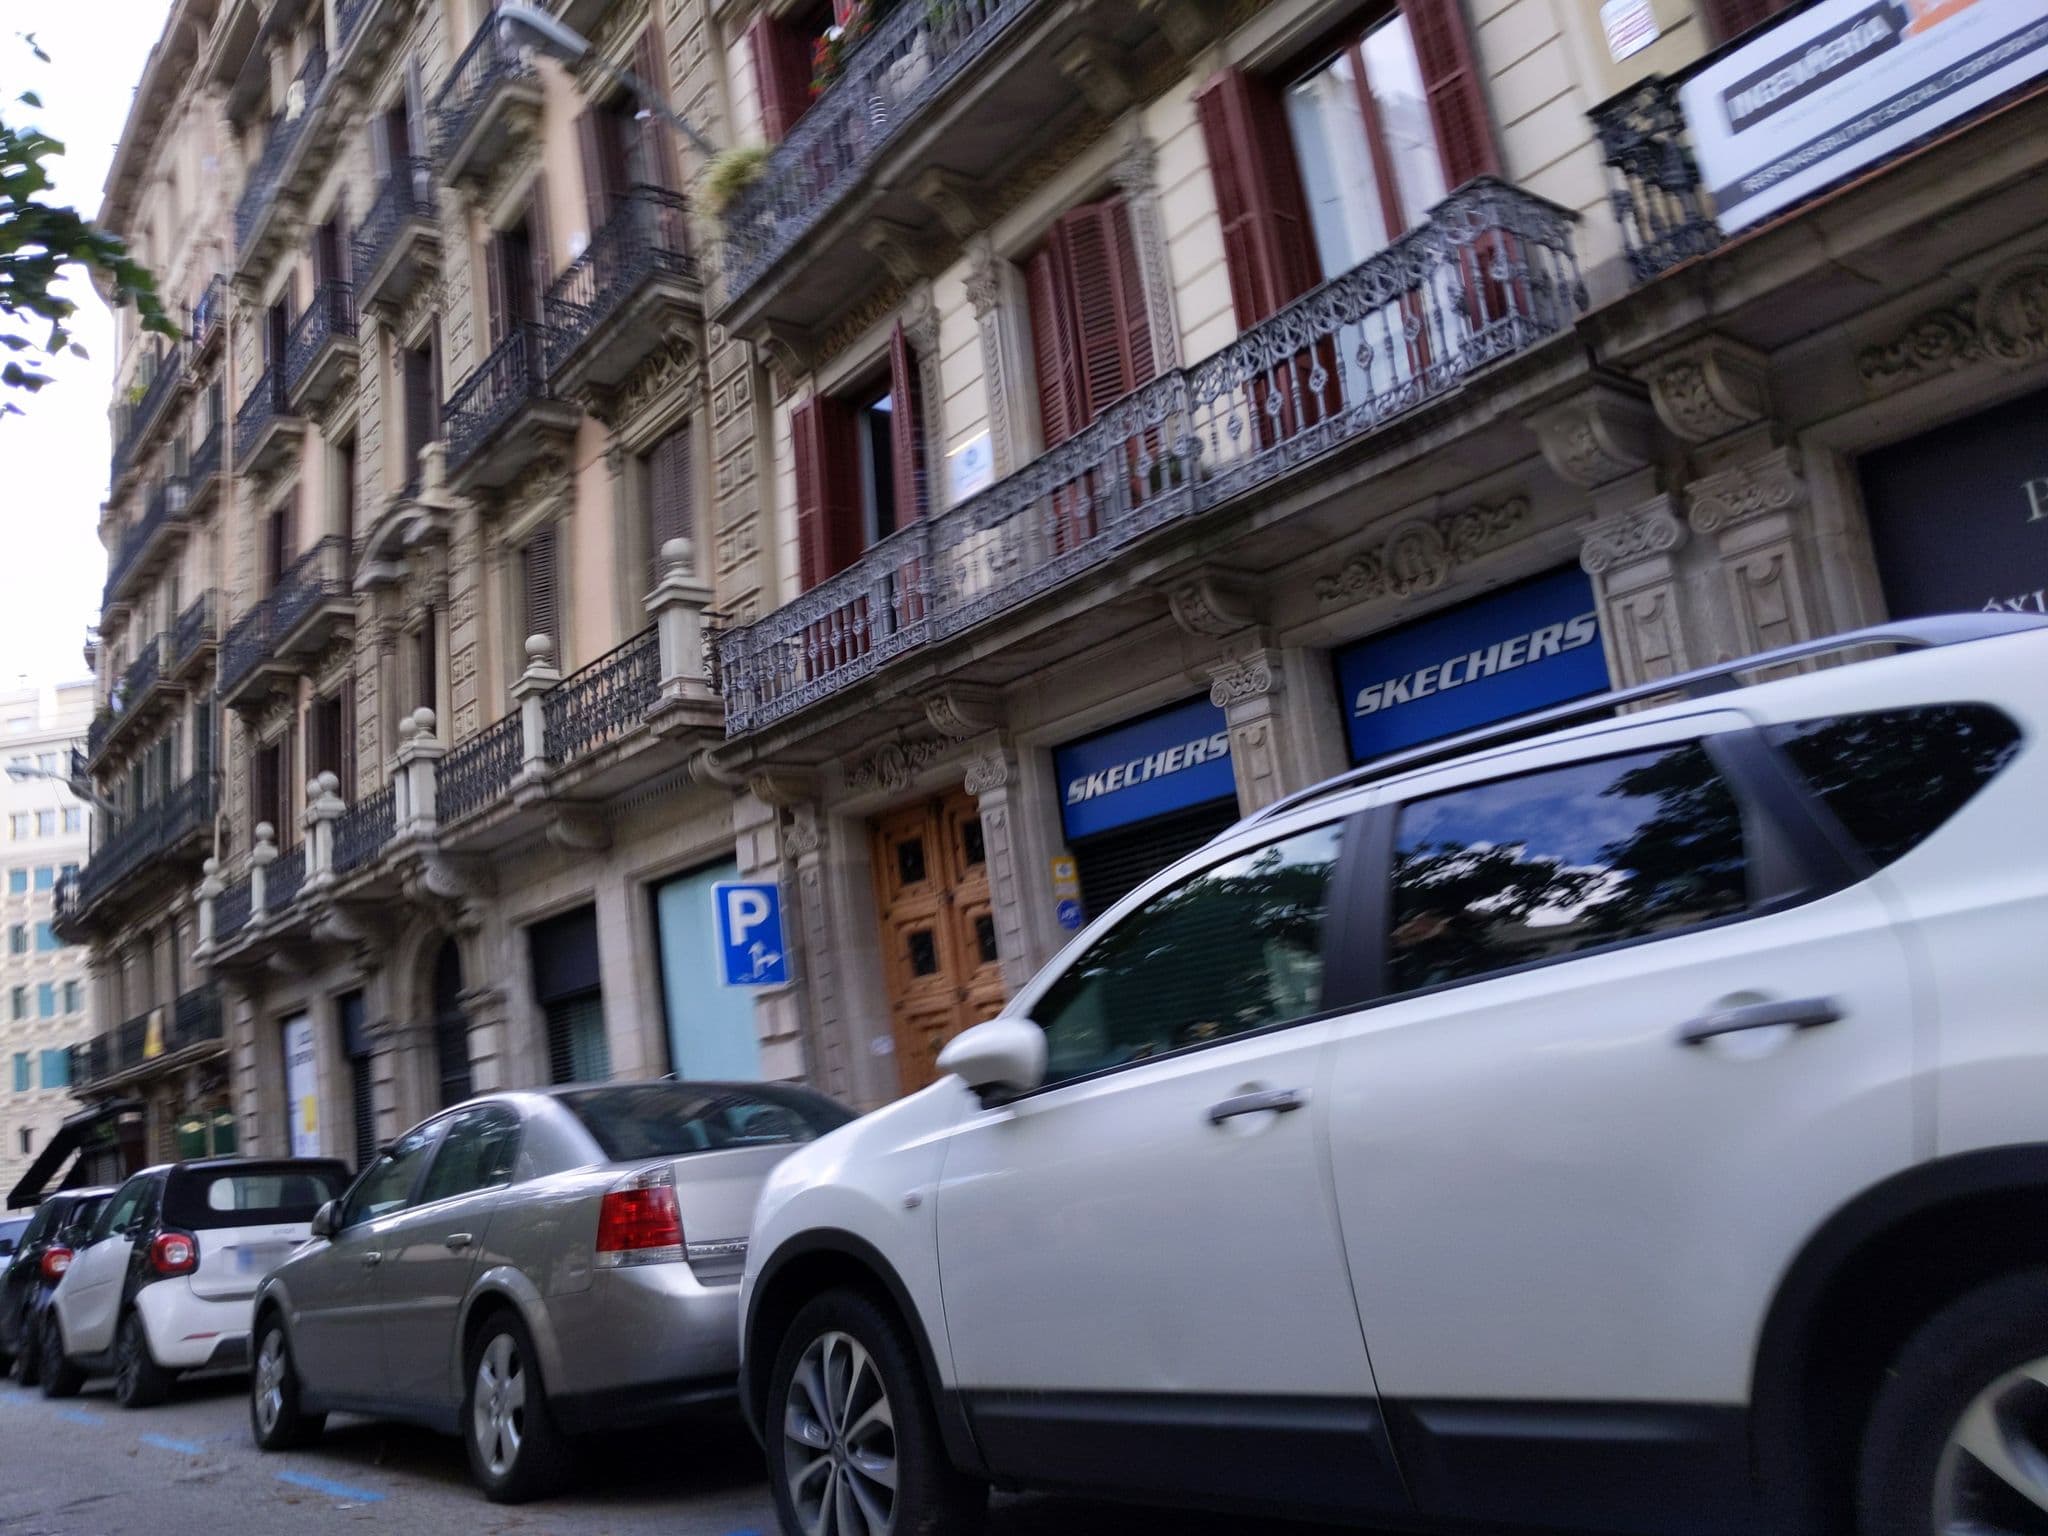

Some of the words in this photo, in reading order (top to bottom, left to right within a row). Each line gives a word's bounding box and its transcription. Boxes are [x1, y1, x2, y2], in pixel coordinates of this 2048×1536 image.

[1354, 610, 1597, 717] SKECHERS
[1067, 730, 1231, 805] SKECHERS
[727, 889, 771, 946] P
